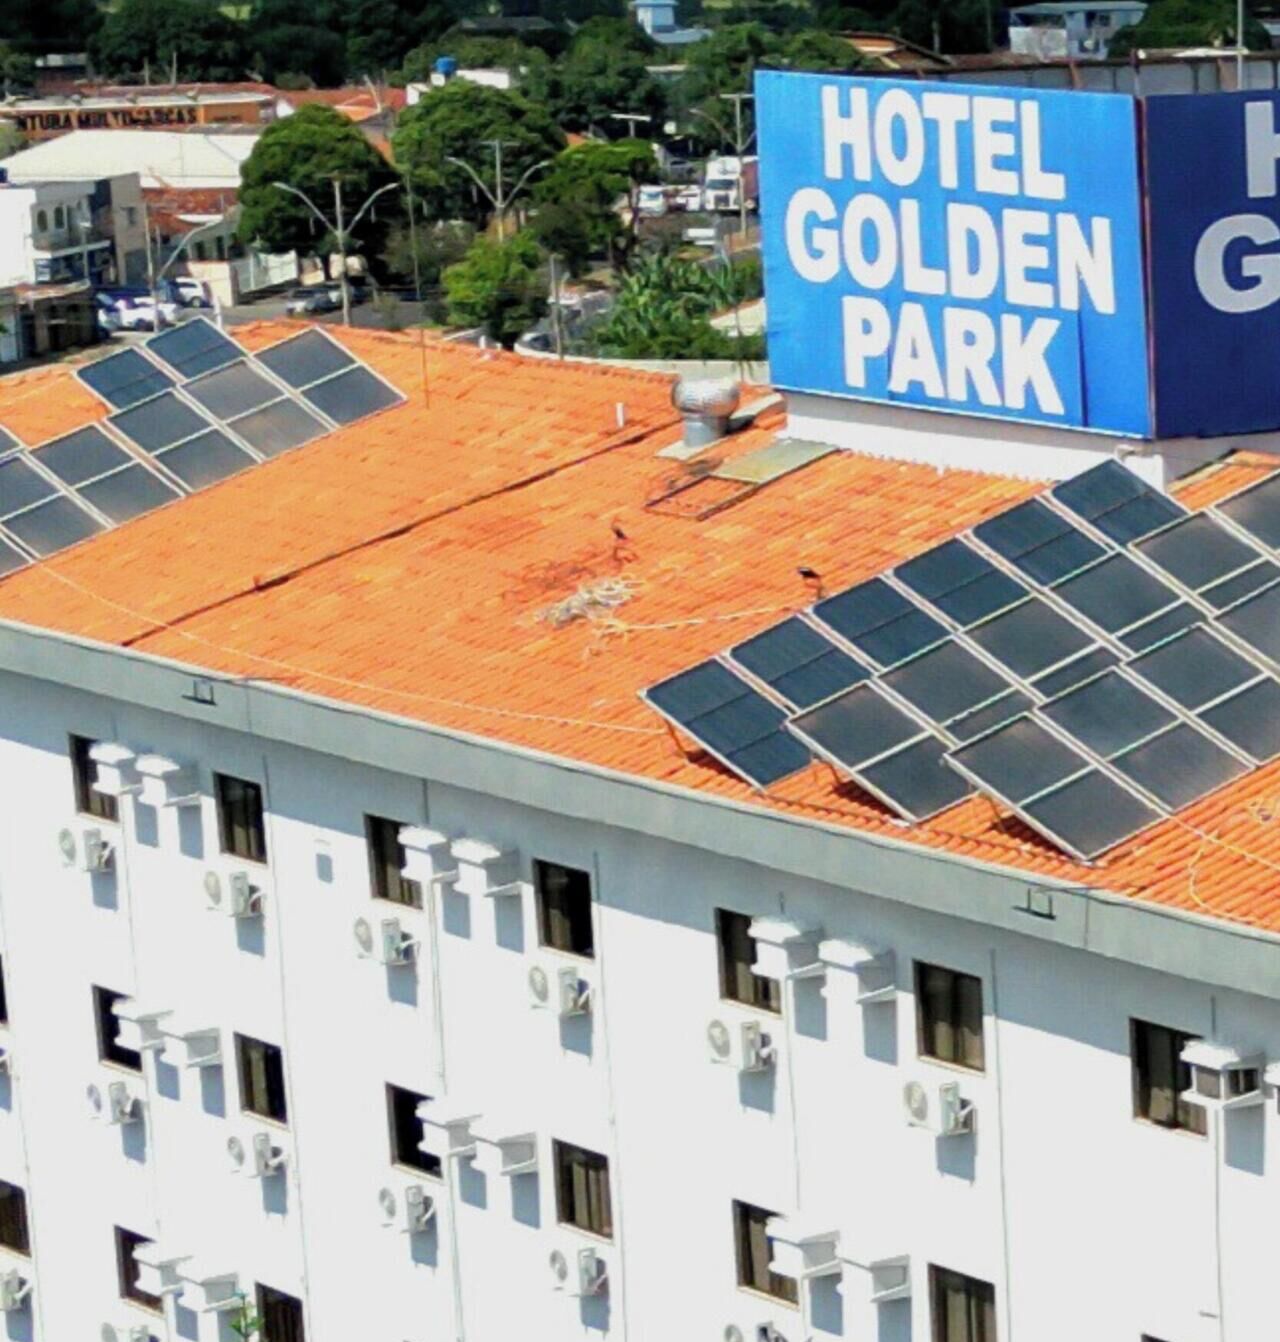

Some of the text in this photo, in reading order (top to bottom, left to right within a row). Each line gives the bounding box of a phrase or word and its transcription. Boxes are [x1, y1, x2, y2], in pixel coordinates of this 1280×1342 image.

[821, 85, 1065, 200] HOTEL
[785, 187, 1116, 314] GOLDEN
[842, 295, 1065, 416] PARK
